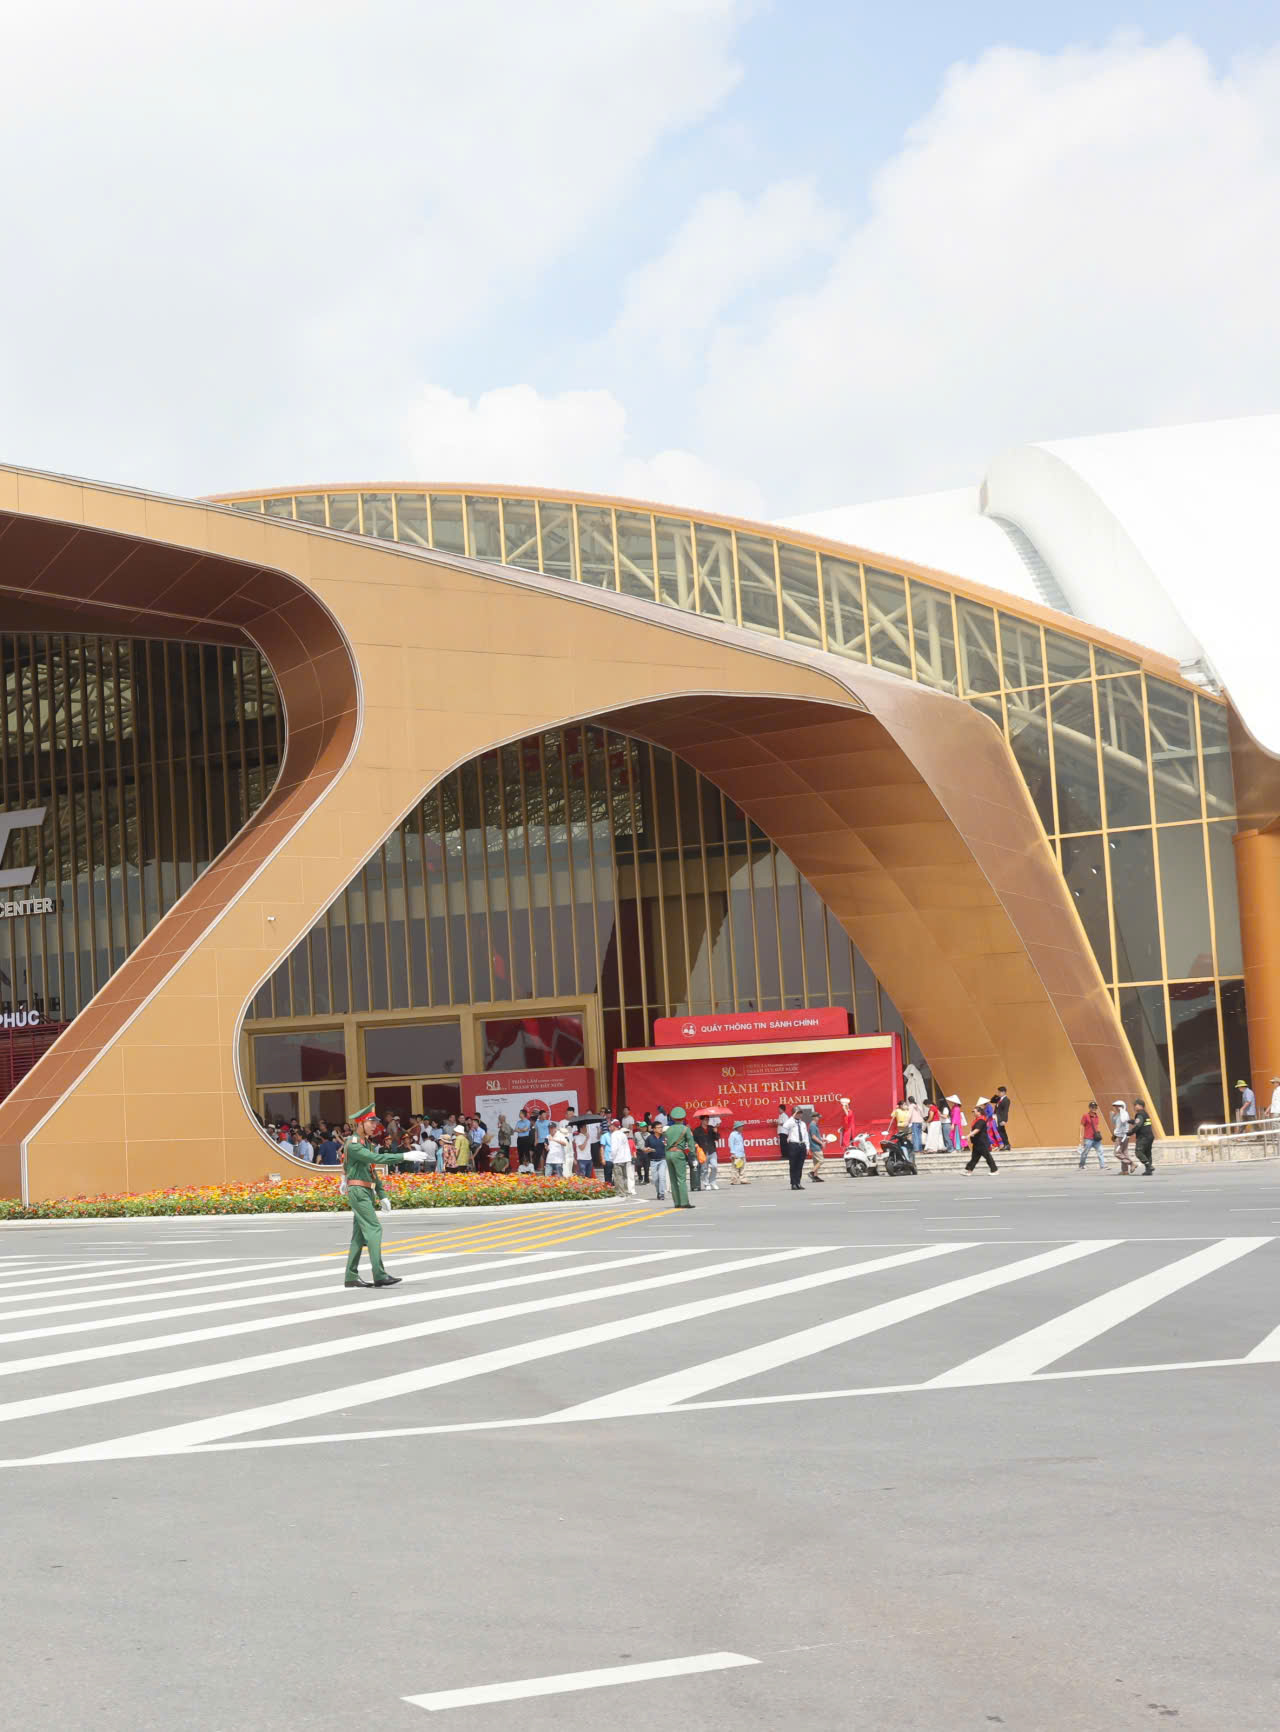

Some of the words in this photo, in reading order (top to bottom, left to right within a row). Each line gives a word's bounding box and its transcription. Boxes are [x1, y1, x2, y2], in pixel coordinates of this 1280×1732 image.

[724, 1022, 752, 1031] THÔNG
[754, 1021, 767, 1030] TIN
[721, 1066, 736, 1078] 80
[486, 1080, 501, 1091] 80
[718, 1081, 758, 1095] HÀNH
[761, 1079, 807, 1093] TRÌNH
[754, 1097, 770, 1106] DO
[813, 1091, 842, 1103] PHÚC
